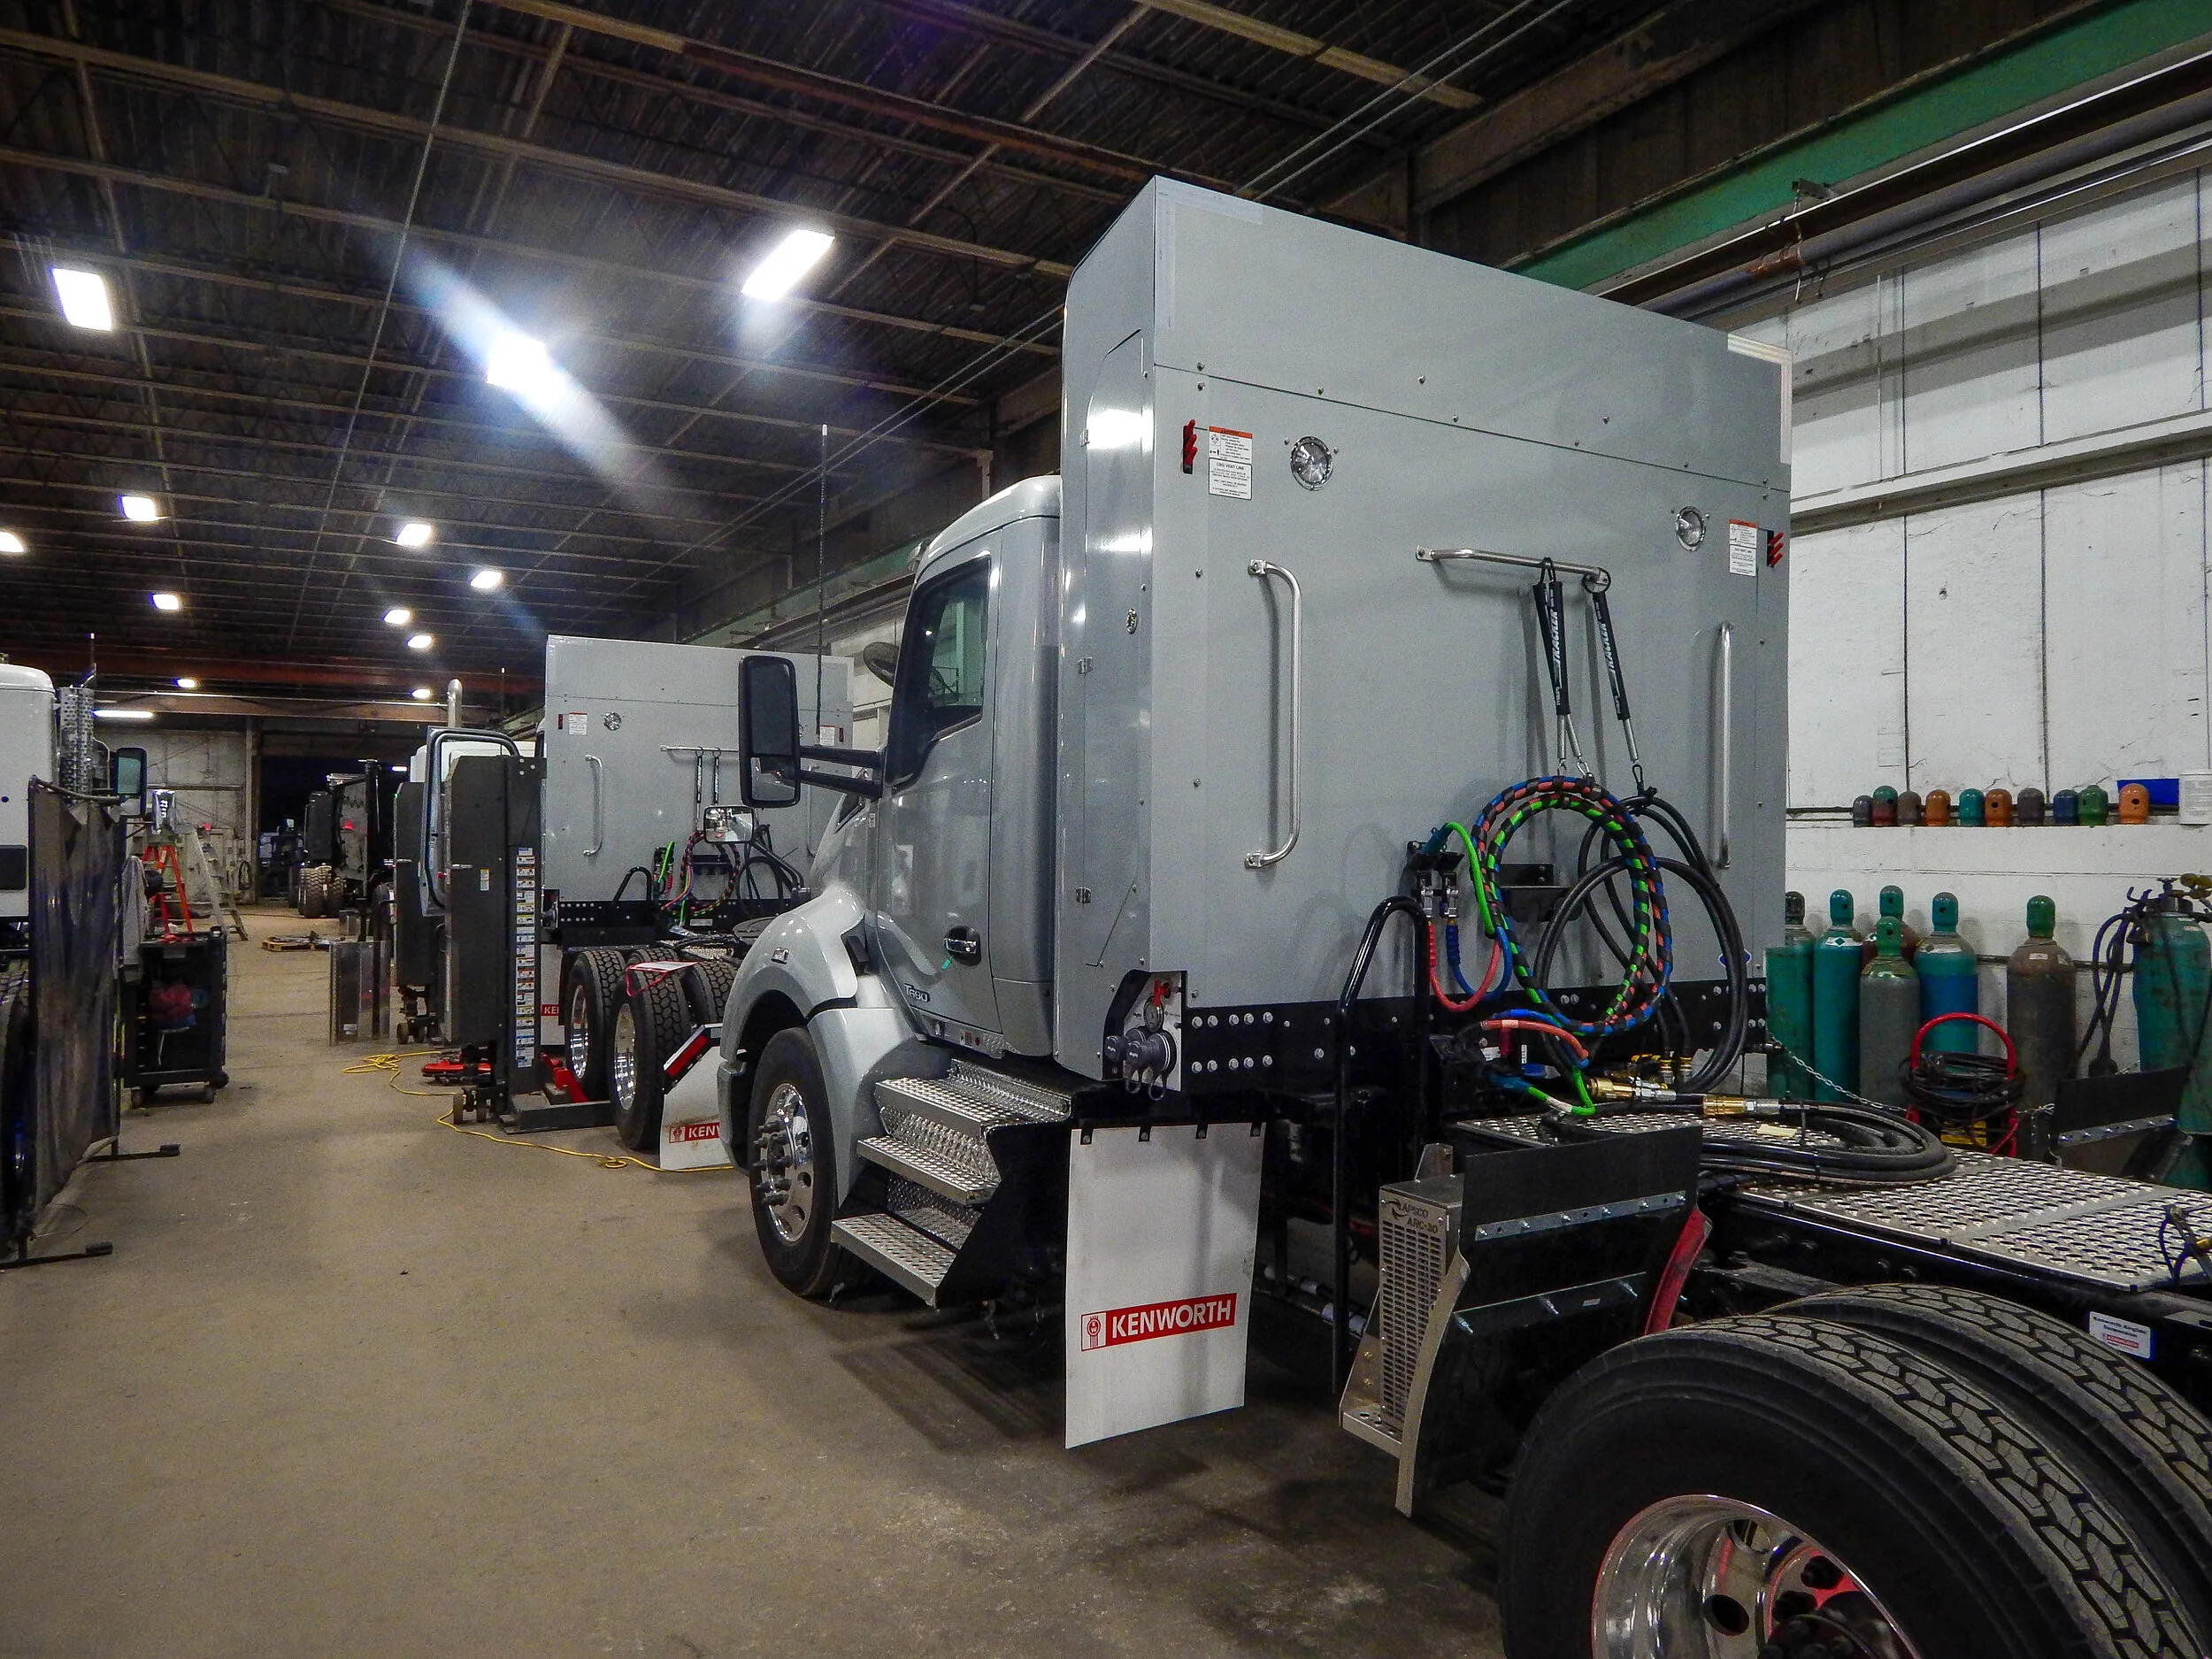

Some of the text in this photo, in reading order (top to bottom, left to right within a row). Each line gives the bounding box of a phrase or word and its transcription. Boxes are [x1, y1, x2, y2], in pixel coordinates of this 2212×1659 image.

[1550, 609, 1560, 663] TRACKER
[1599, 622, 1615, 672] TRACKER
[903, 983, 929, 1002] T680
[1112, 1300, 1232, 1339] KENWORTH
